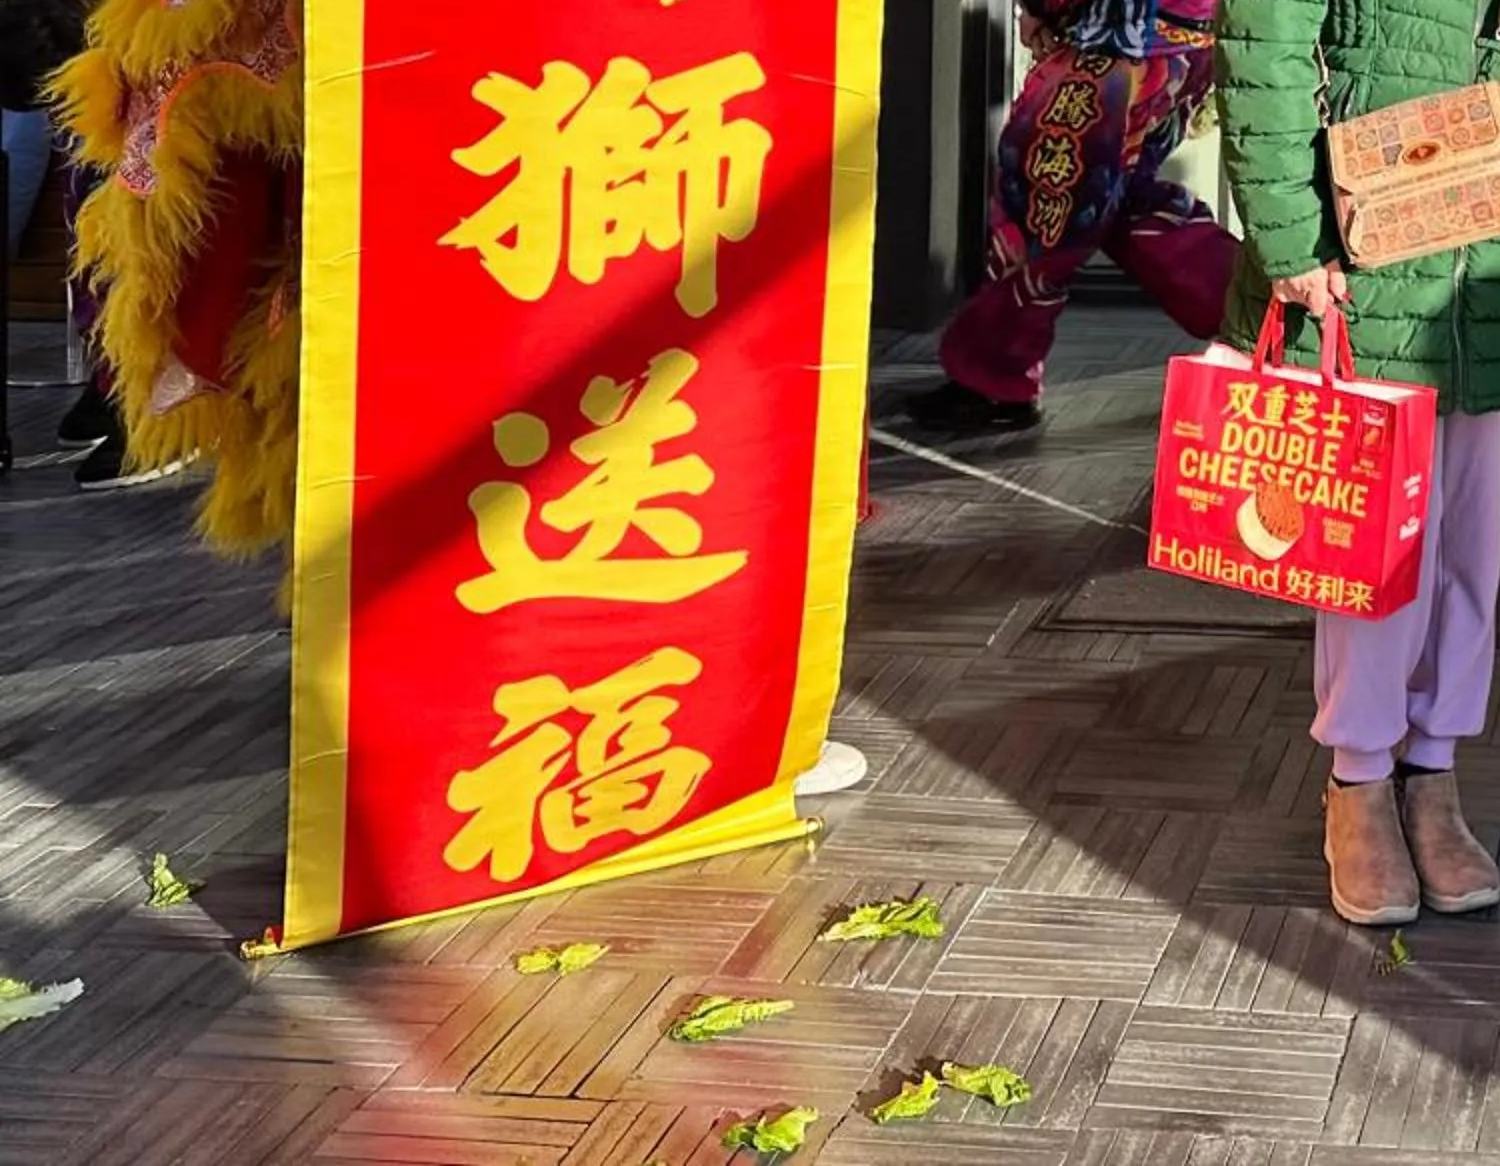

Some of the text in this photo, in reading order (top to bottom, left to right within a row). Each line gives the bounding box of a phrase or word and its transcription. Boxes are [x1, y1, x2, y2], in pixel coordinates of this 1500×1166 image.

[1221, 382, 1350, 438] 双重芝士
[1220, 422, 1340, 475] DOUBLE
[1179, 447, 1369, 518] CHEESECAKE
[1154, 534, 1375, 612] Holiland 好利来
